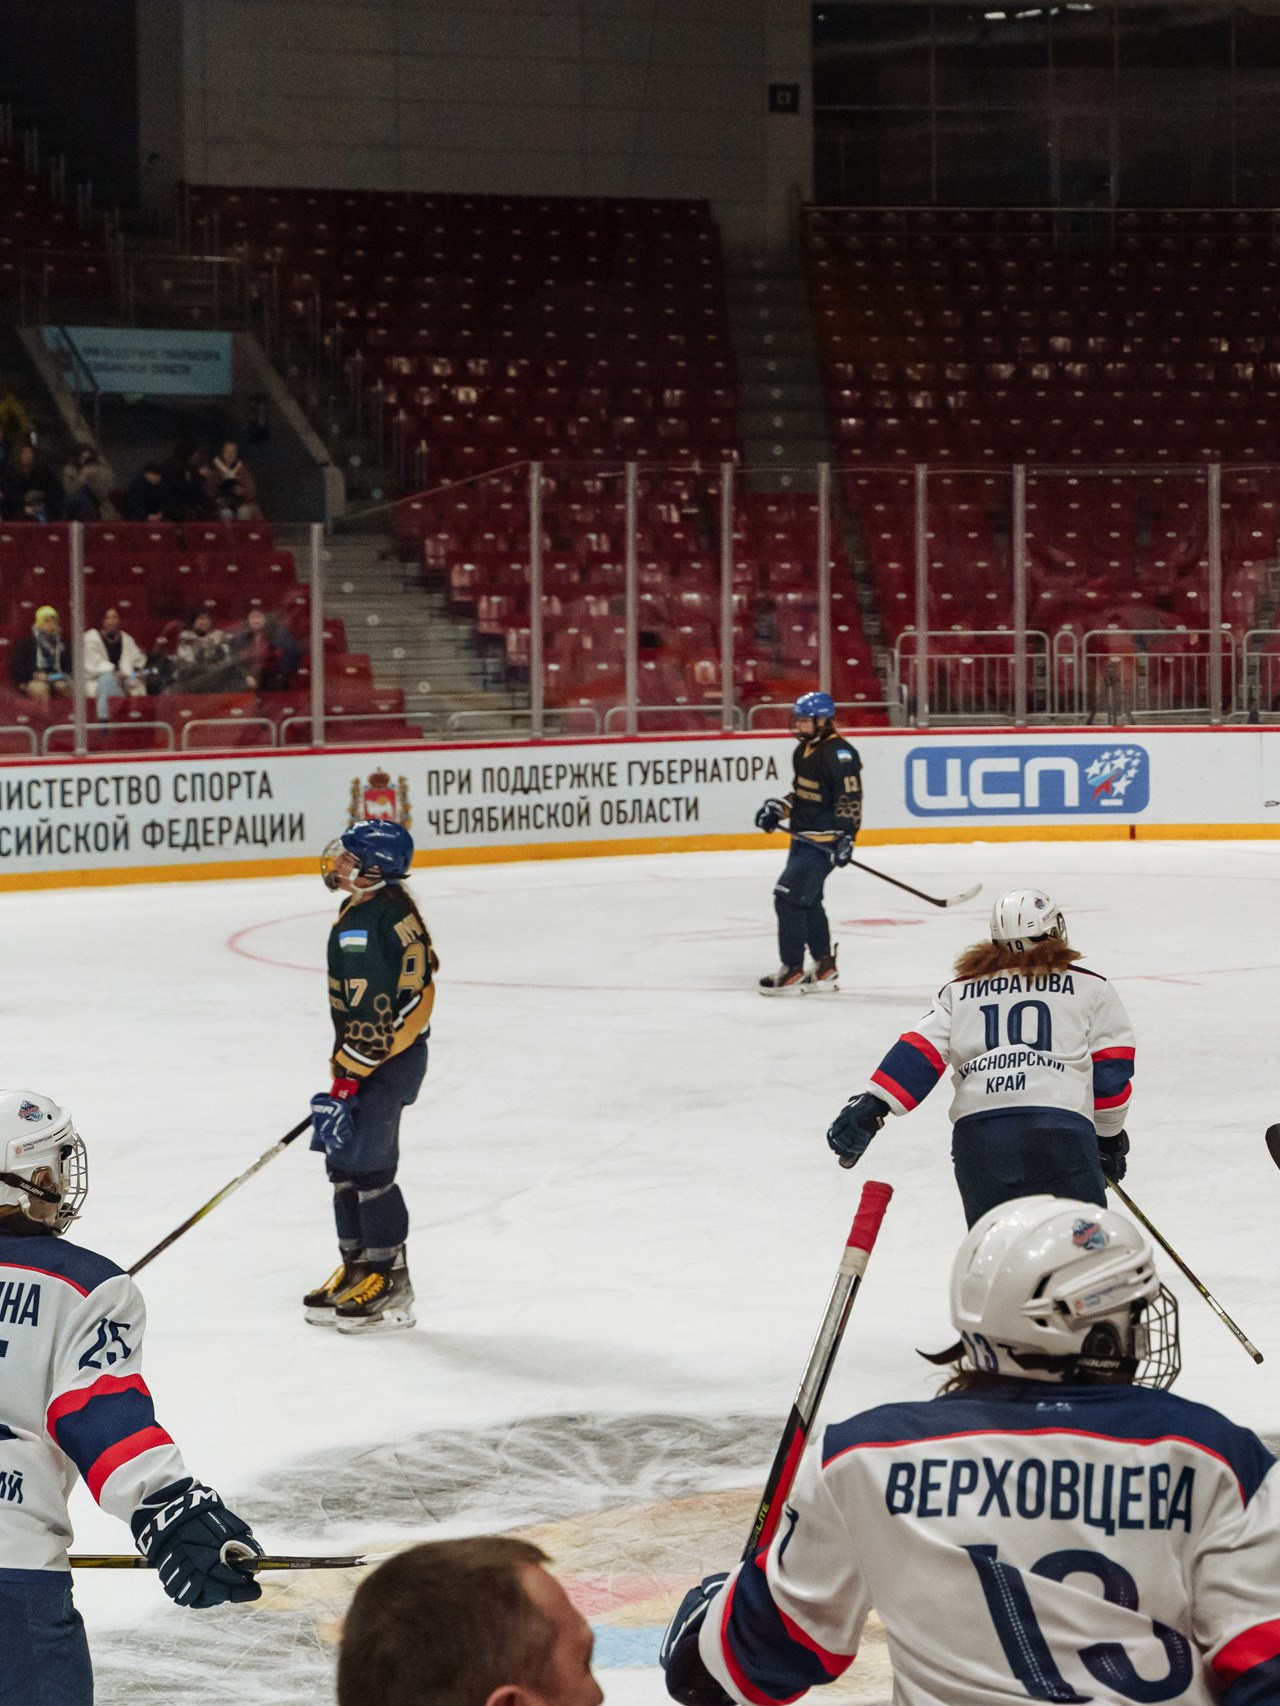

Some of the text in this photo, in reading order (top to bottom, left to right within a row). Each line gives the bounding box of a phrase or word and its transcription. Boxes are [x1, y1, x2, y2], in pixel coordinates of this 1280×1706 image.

[174, 770, 273, 803] СПОРТА
[427, 756, 779, 796] ПРИ ПОДДЕРЖКЕ ГУБЕРНАТОРА
[142, 813, 305, 850] ФЕДЕРАЦИИ
[427, 796, 700, 836] ЧЕЛЯБИНСКОЙ ОБЛАСТИ
[979, 1000, 1052, 1052] 10
[986, 1072, 1027, 1094] КРАЙ
[885, 1458, 1196, 1536] ВЕРХОВЦЕВА
[137, 1485, 218, 1555] CCM
[960, 1543, 1193, 1701] 13
